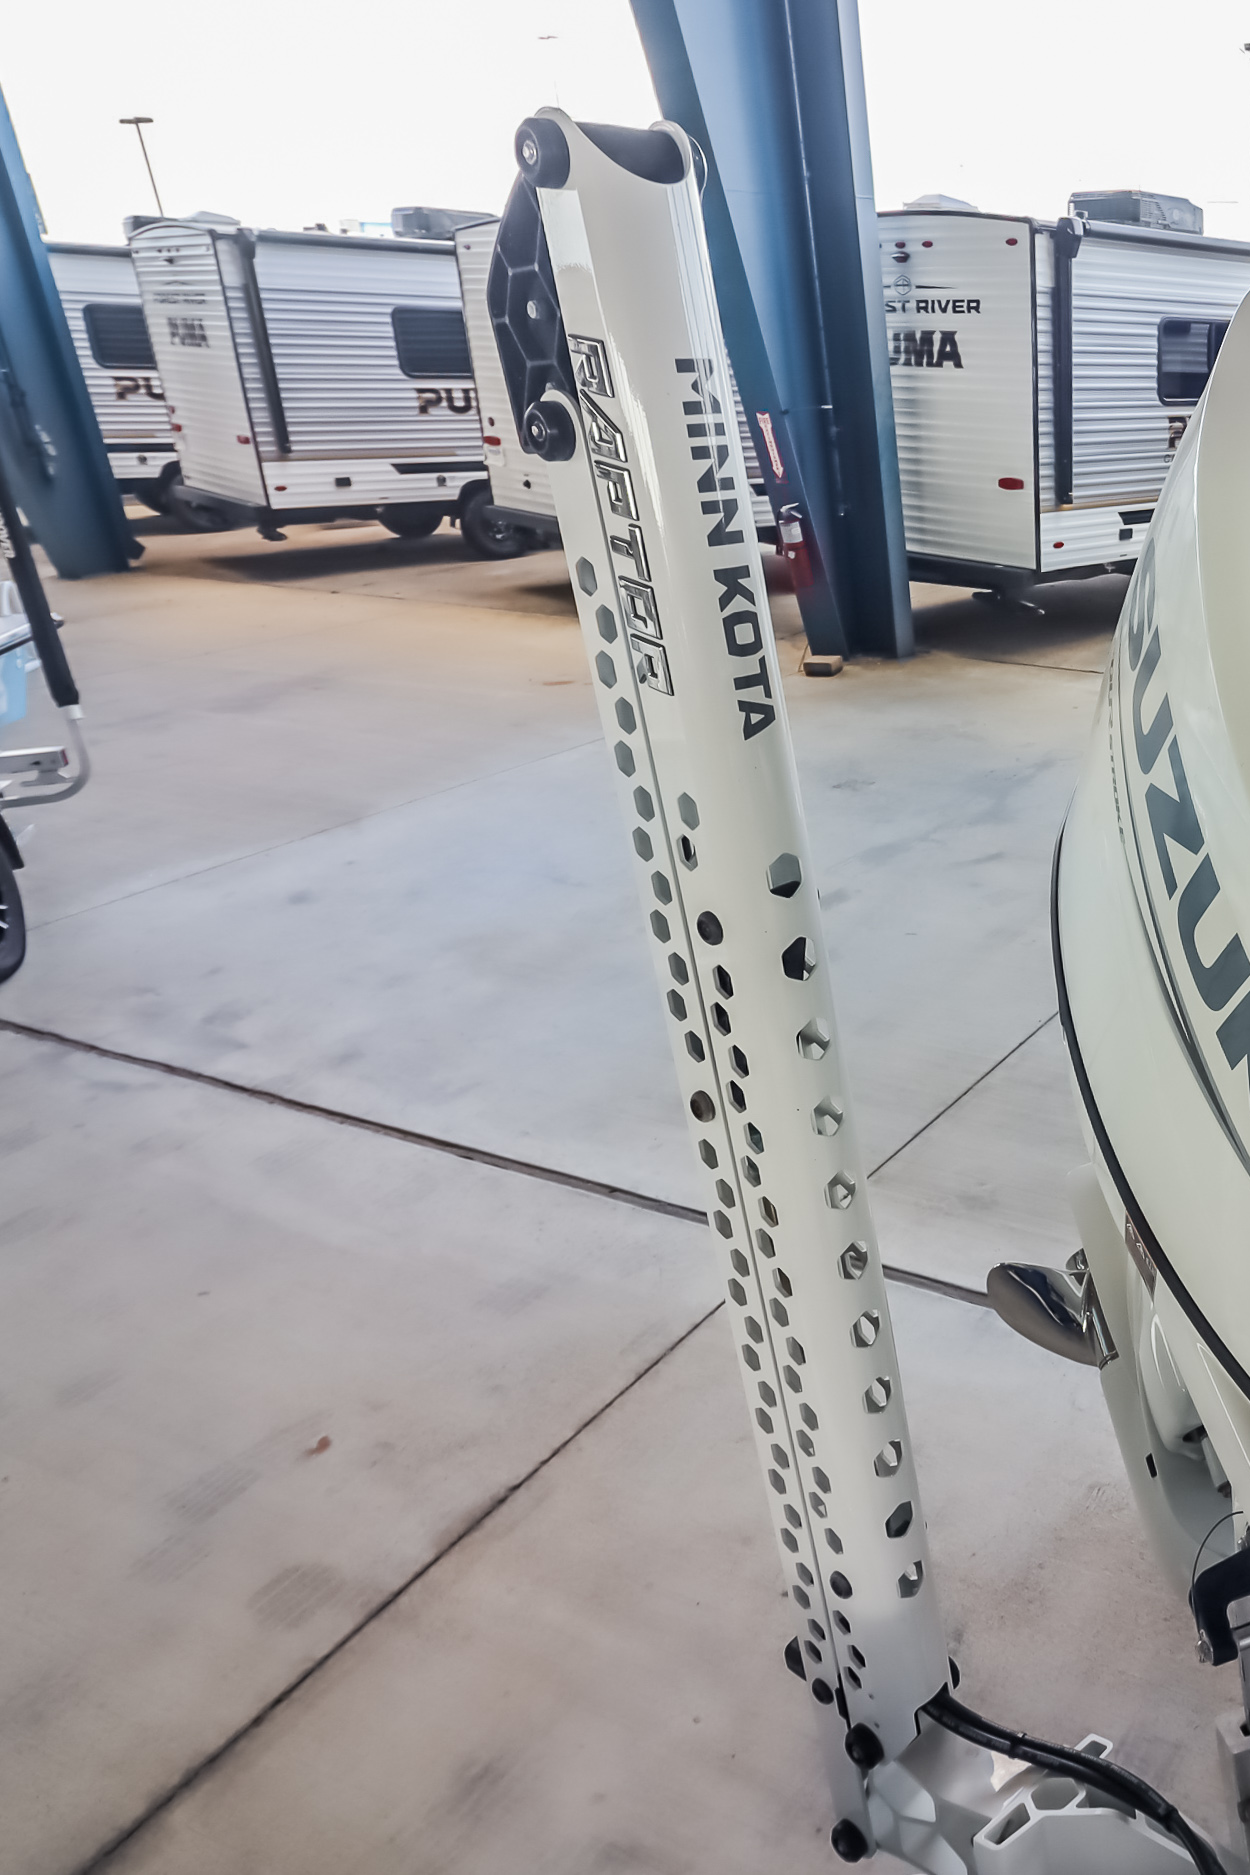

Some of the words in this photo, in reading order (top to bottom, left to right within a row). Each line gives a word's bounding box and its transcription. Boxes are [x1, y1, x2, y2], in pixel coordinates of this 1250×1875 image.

[888, 329, 964, 369] UMA
[915, 298, 981, 314] RIVER
[567, 333, 674, 697] RAPTOR
[674, 358, 745, 548] MINN
[713, 564, 777, 741] KOTA
